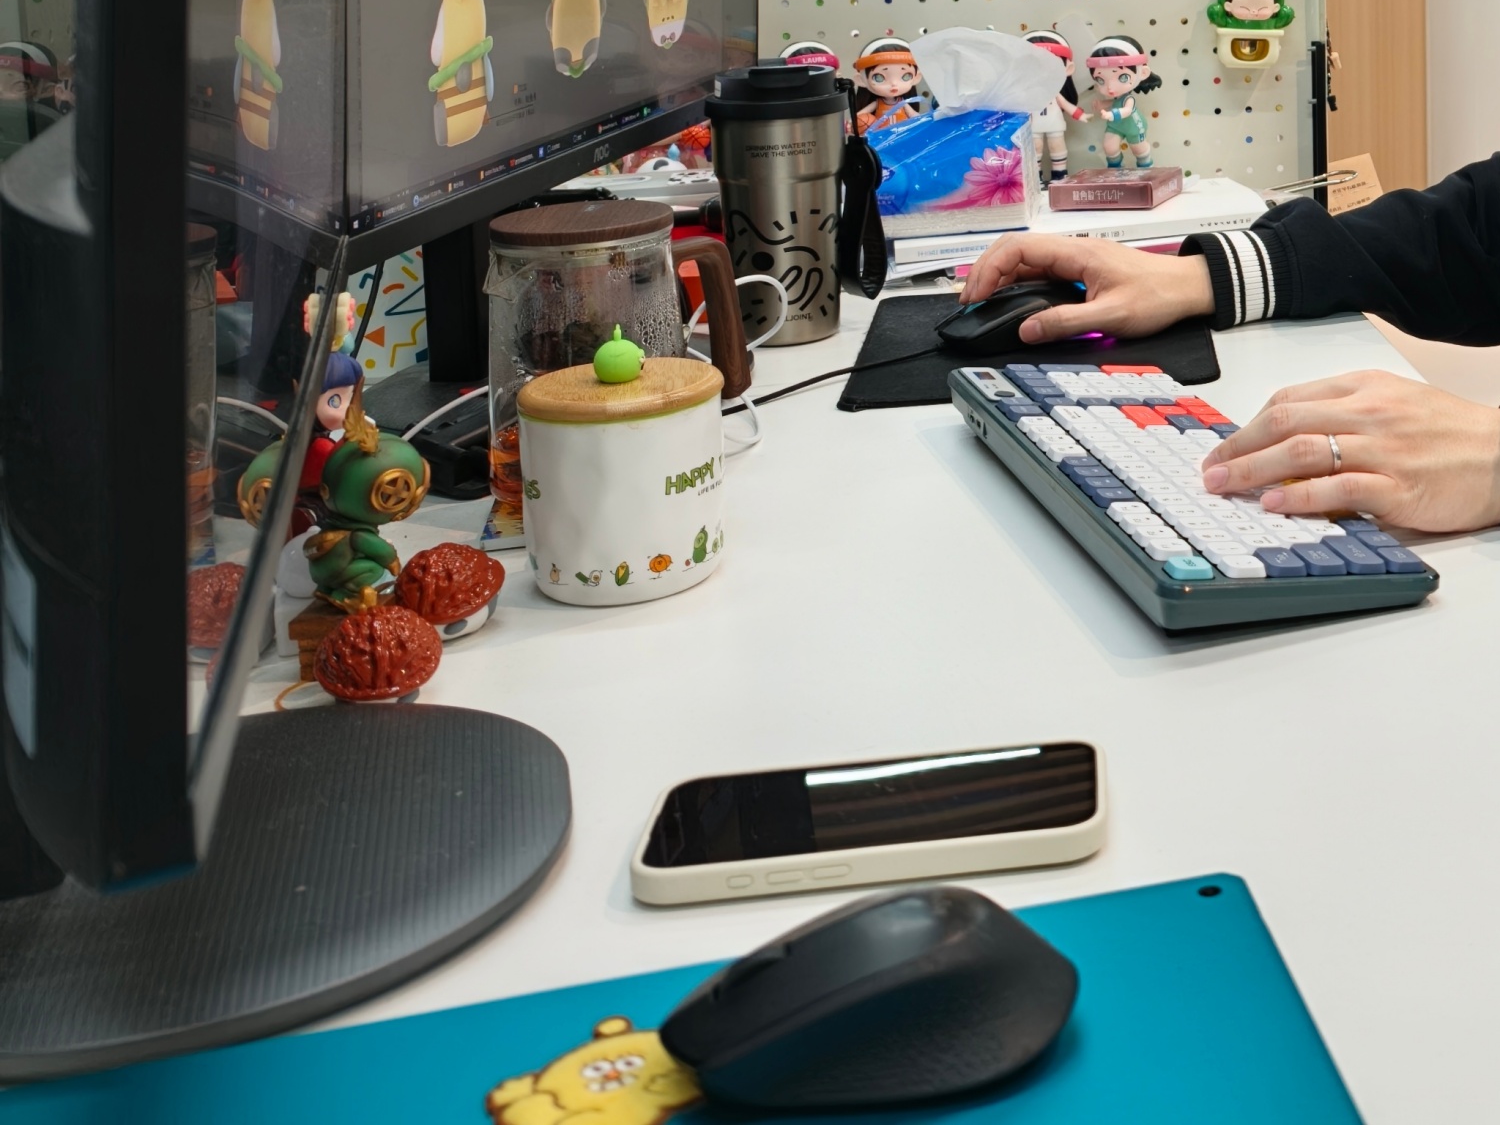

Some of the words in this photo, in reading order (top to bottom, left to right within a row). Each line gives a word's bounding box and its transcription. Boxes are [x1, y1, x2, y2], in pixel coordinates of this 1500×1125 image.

[802, 56, 828, 64] LAURA
[745, 144, 780, 152] DRINKING
[780, 142, 806, 150] WATER
[786, 148, 813, 156] WORLD
[665, 456, 715, 496] HAPPY
[697, 486, 709, 496] LIFE
